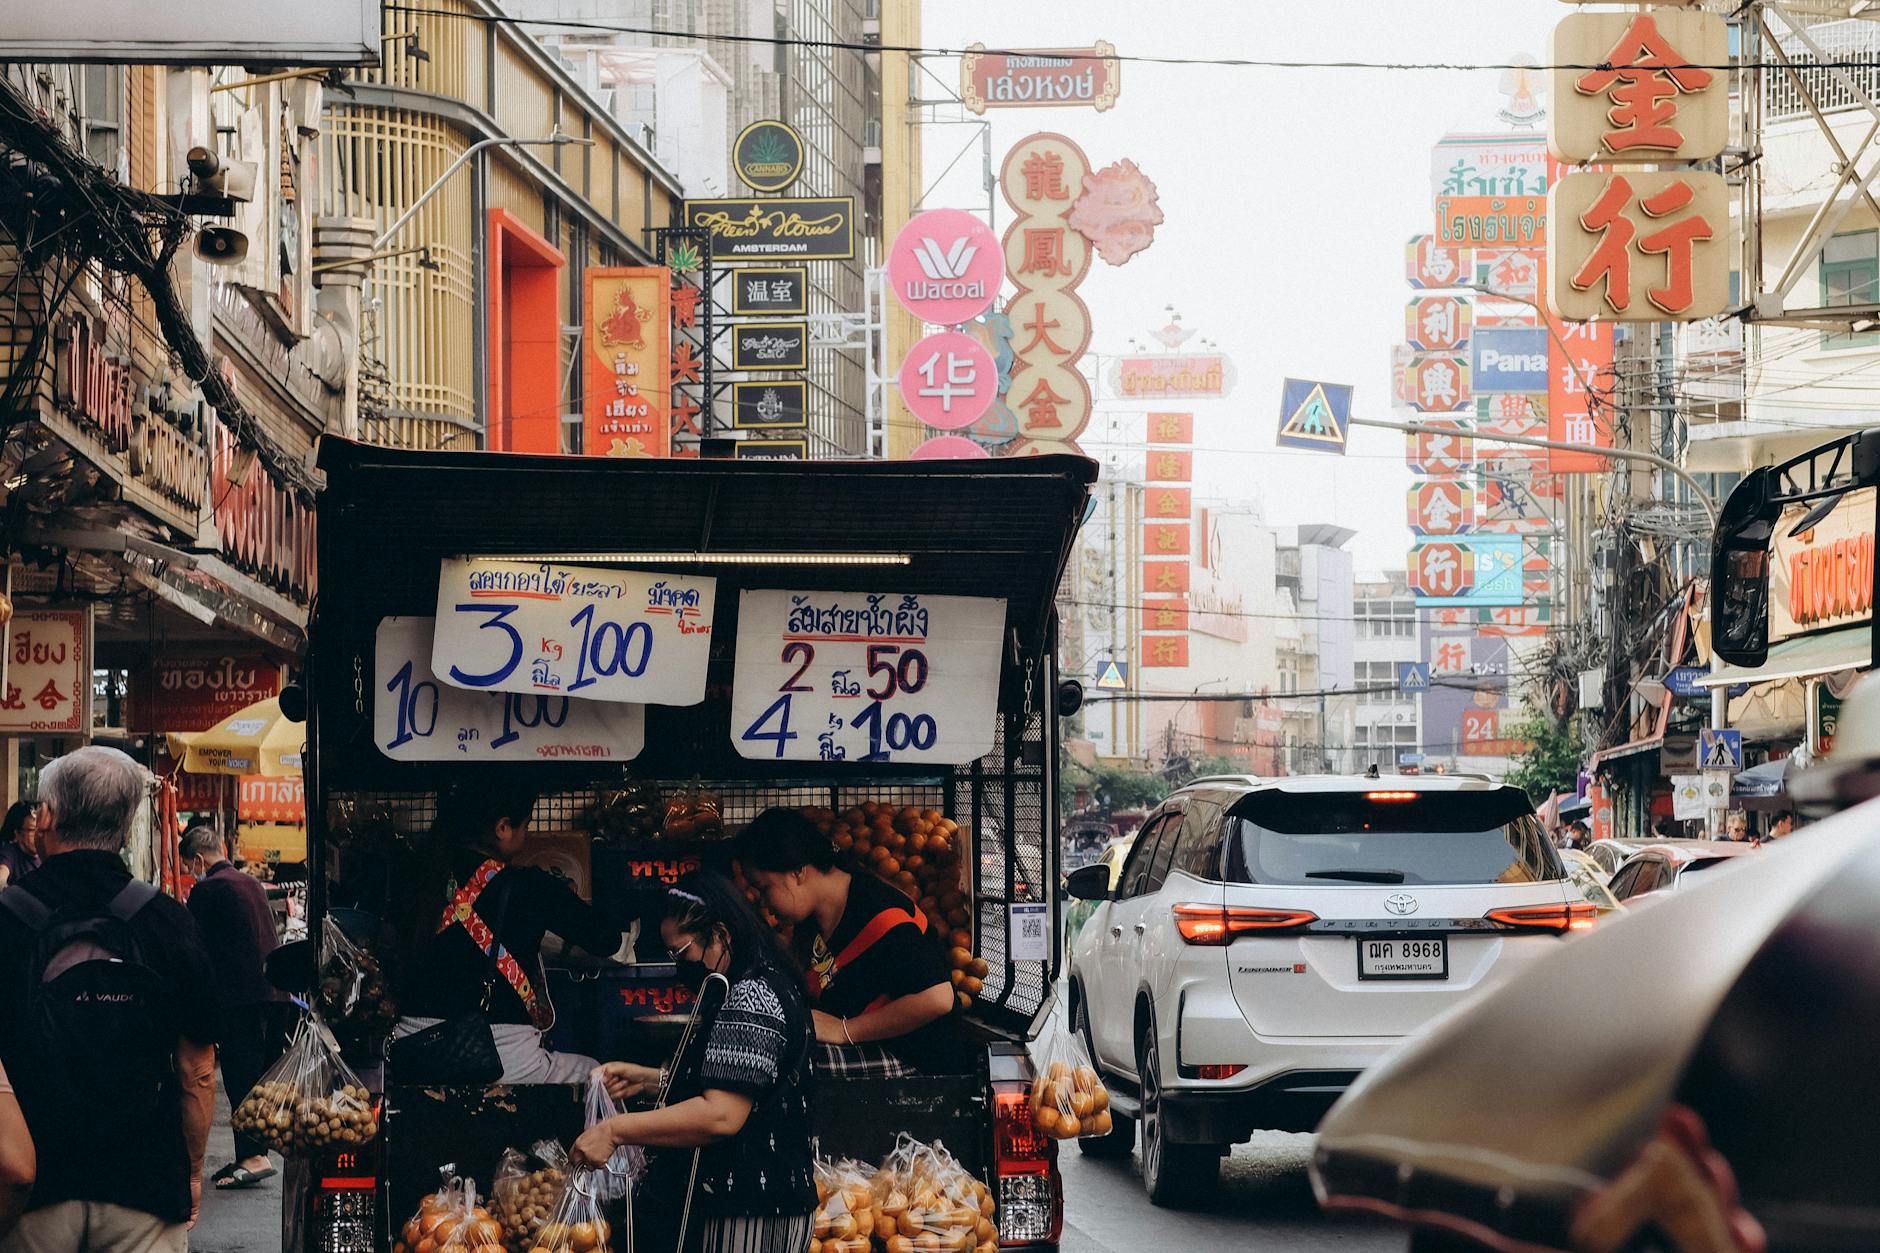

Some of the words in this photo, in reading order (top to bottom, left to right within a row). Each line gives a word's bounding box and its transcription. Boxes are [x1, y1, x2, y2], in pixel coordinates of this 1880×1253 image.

[987, 67, 1094, 101] เล่งหงษ์
[748, 163, 789, 174] CANNABIS
[1570, 14, 1714, 314] 金行
[766, 210, 844, 237] House
[732, 243, 807, 252] AMSTERDAM
[747, 279, 793, 302] 温室
[906, 279, 985, 301] Wacoal
[1018, 150, 1073, 455] 龍鳳大金
[917, 351, 978, 411] 华
[469, 564, 566, 596] ลองกองใต้
[787, 595, 929, 638] ส้มสายน้ำผึ้ง
[450, 604, 523, 686] 3
[566, 603, 653, 692] 100
[161, 656, 256, 689] ทองใบ
[532, 658, 561, 687] กิโล
[779, 641, 816, 692] 2
[866, 644, 929, 701] 50
[386, 660, 439, 750] 10
[457, 727, 480, 753] ลูก
[490, 692, 569, 749] 100
[742, 693, 798, 758] 4
[850, 700, 937, 763] 100
[1466, 717, 1495, 740] 24
[198, 748, 232, 758] EMPOWER
[208, 757, 227, 767] YOUR
[228, 758, 249, 769] VOICE
[1402, 942, 1441, 958] 8968
[1374, 963, 1432, 974] กรุงเทพมหานคร
